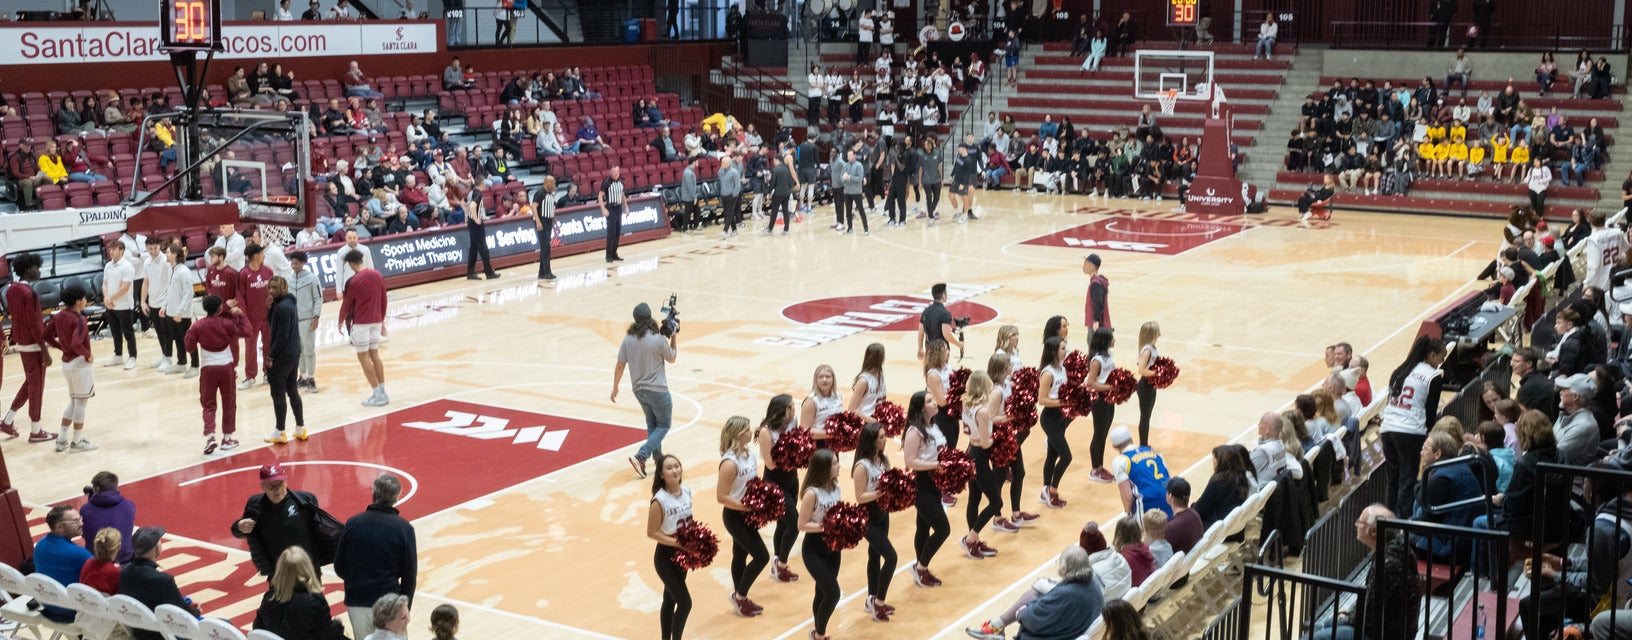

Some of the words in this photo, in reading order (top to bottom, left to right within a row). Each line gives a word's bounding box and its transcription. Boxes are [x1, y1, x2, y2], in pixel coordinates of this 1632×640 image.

[175, 2, 204, 40] 30
[1175, 4, 1193, 22] 30
[382, 42, 399, 51] SANTA
[401, 42, 418, 50] CLARA
[1187, 194, 1233, 204] UNIVERSITY
[79, 207, 127, 224] SPALDING
[383, 241, 415, 257] Sports
[415, 236, 457, 251] Medicine
[495, 226, 537, 247] Serving
[387, 254, 427, 271] Physical
[426, 249, 463, 264] Therapy
[1603, 246, 1619, 266] 22
[1146, 459, 1164, 480] 2
